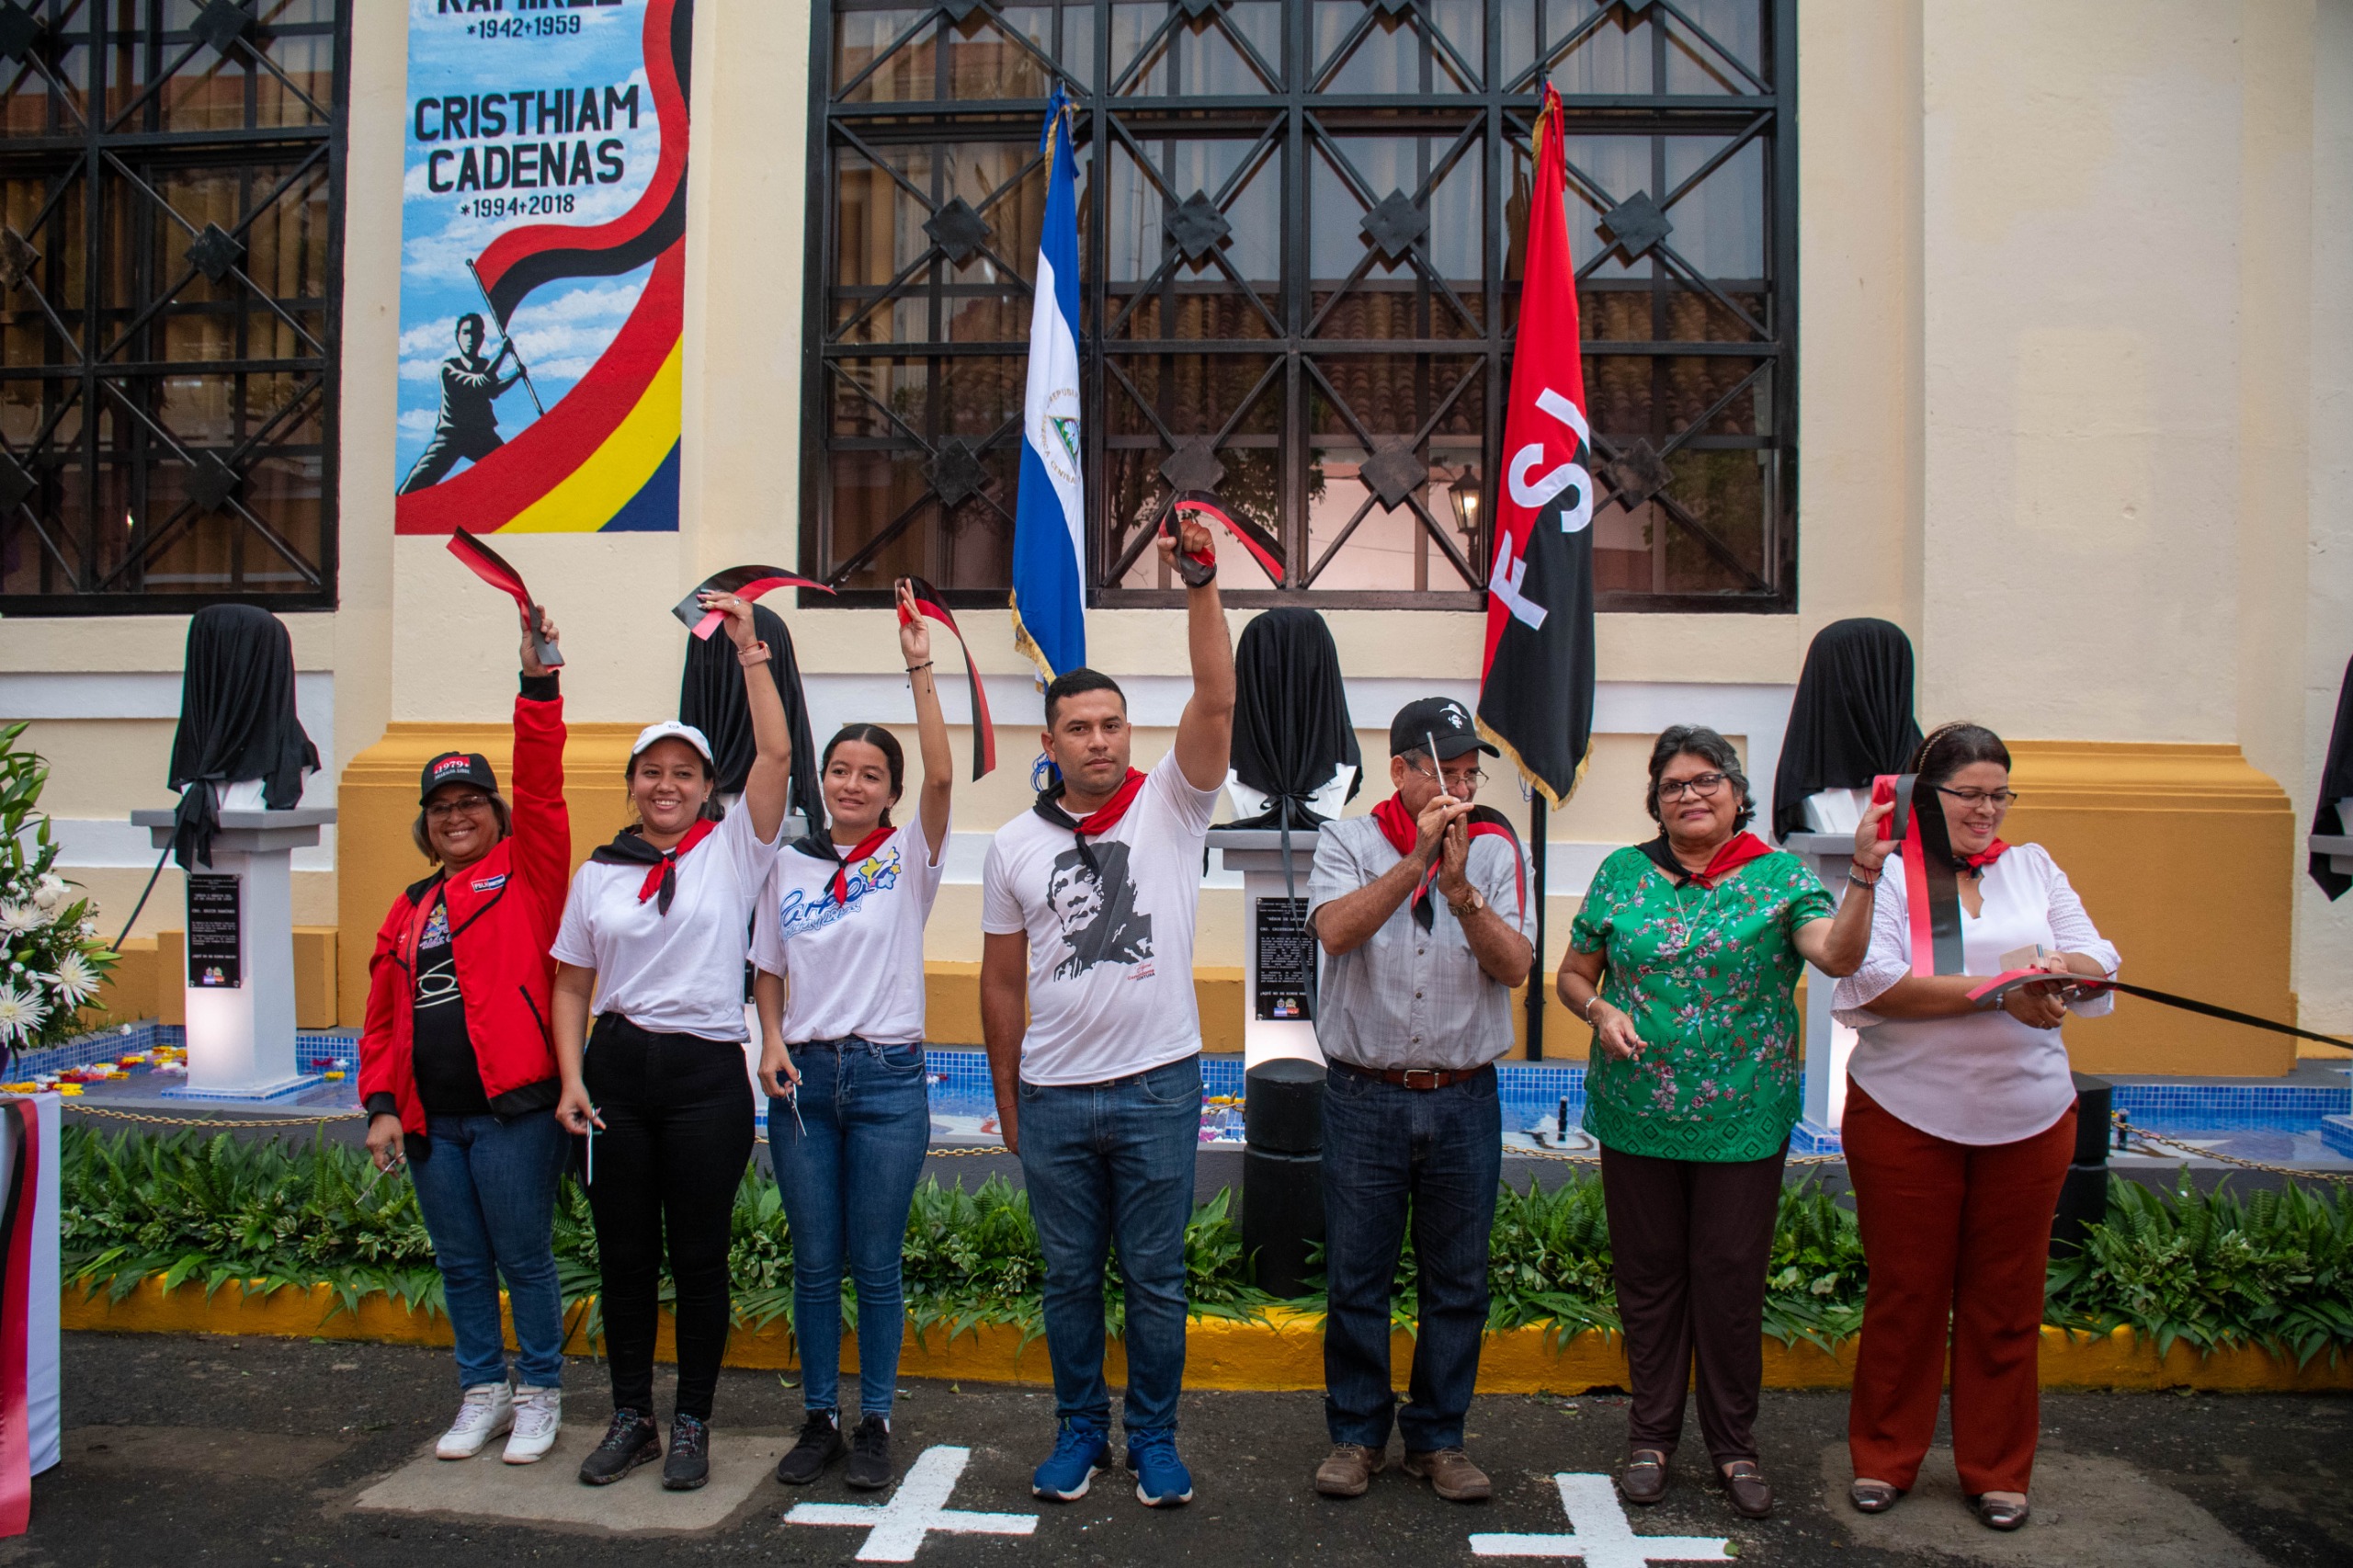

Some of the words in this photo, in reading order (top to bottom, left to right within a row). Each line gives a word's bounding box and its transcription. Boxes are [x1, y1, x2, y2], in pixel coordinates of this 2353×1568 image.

[415, 85, 639, 142] CRISTHIAM
[427, 139, 624, 193] CADENAS
[438, 760, 463, 773] 1979
